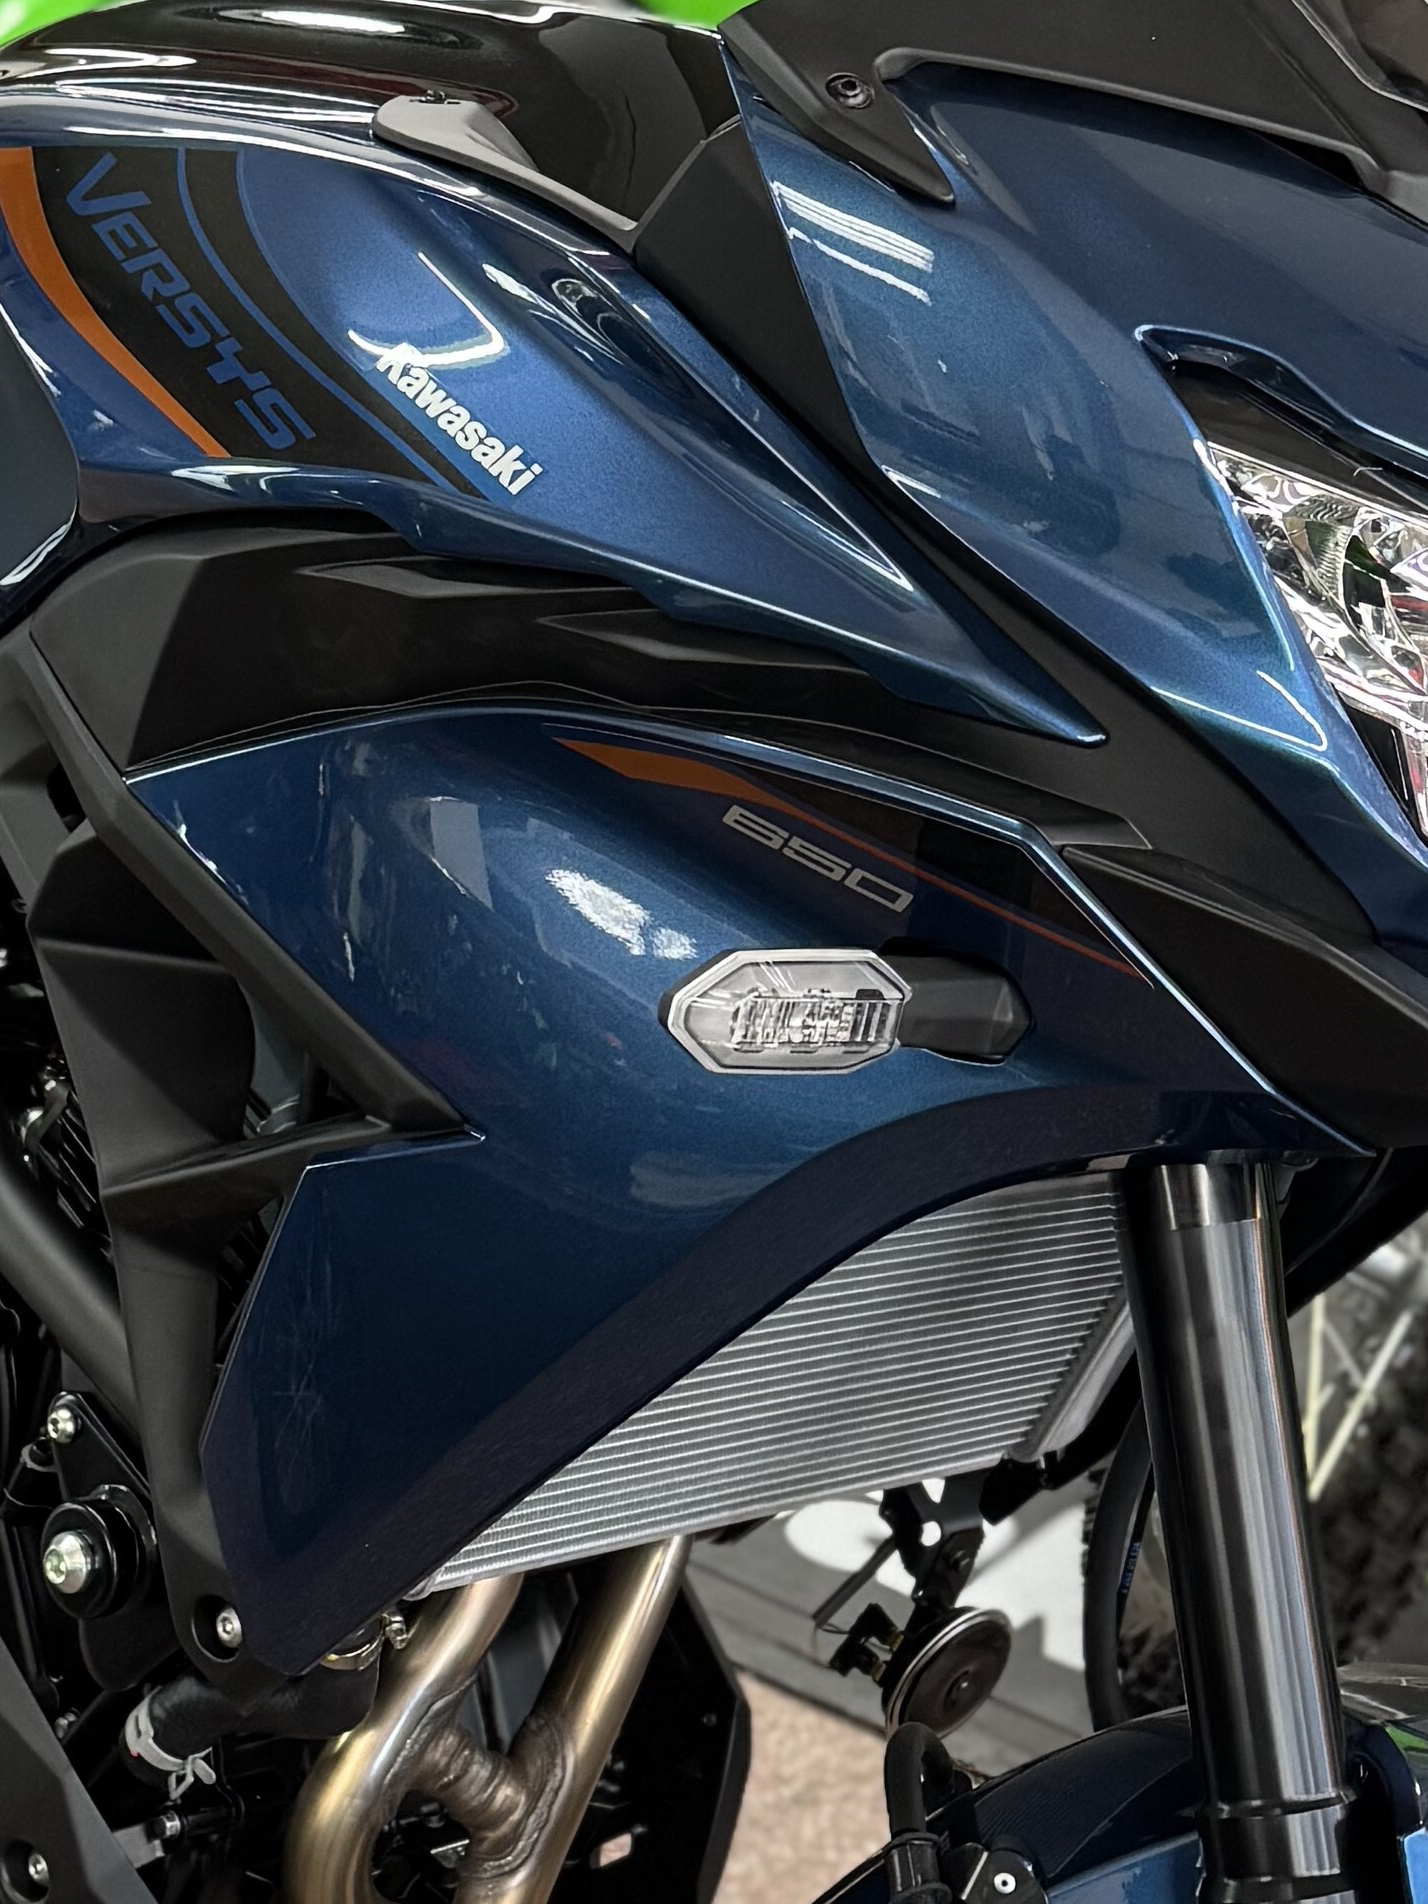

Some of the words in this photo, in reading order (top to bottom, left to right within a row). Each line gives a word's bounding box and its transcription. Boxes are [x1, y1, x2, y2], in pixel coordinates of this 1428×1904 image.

[66, 152, 316, 450] VERSYS
[375, 343, 543, 496] Kawasaki
[721, 804, 914, 913] 650
